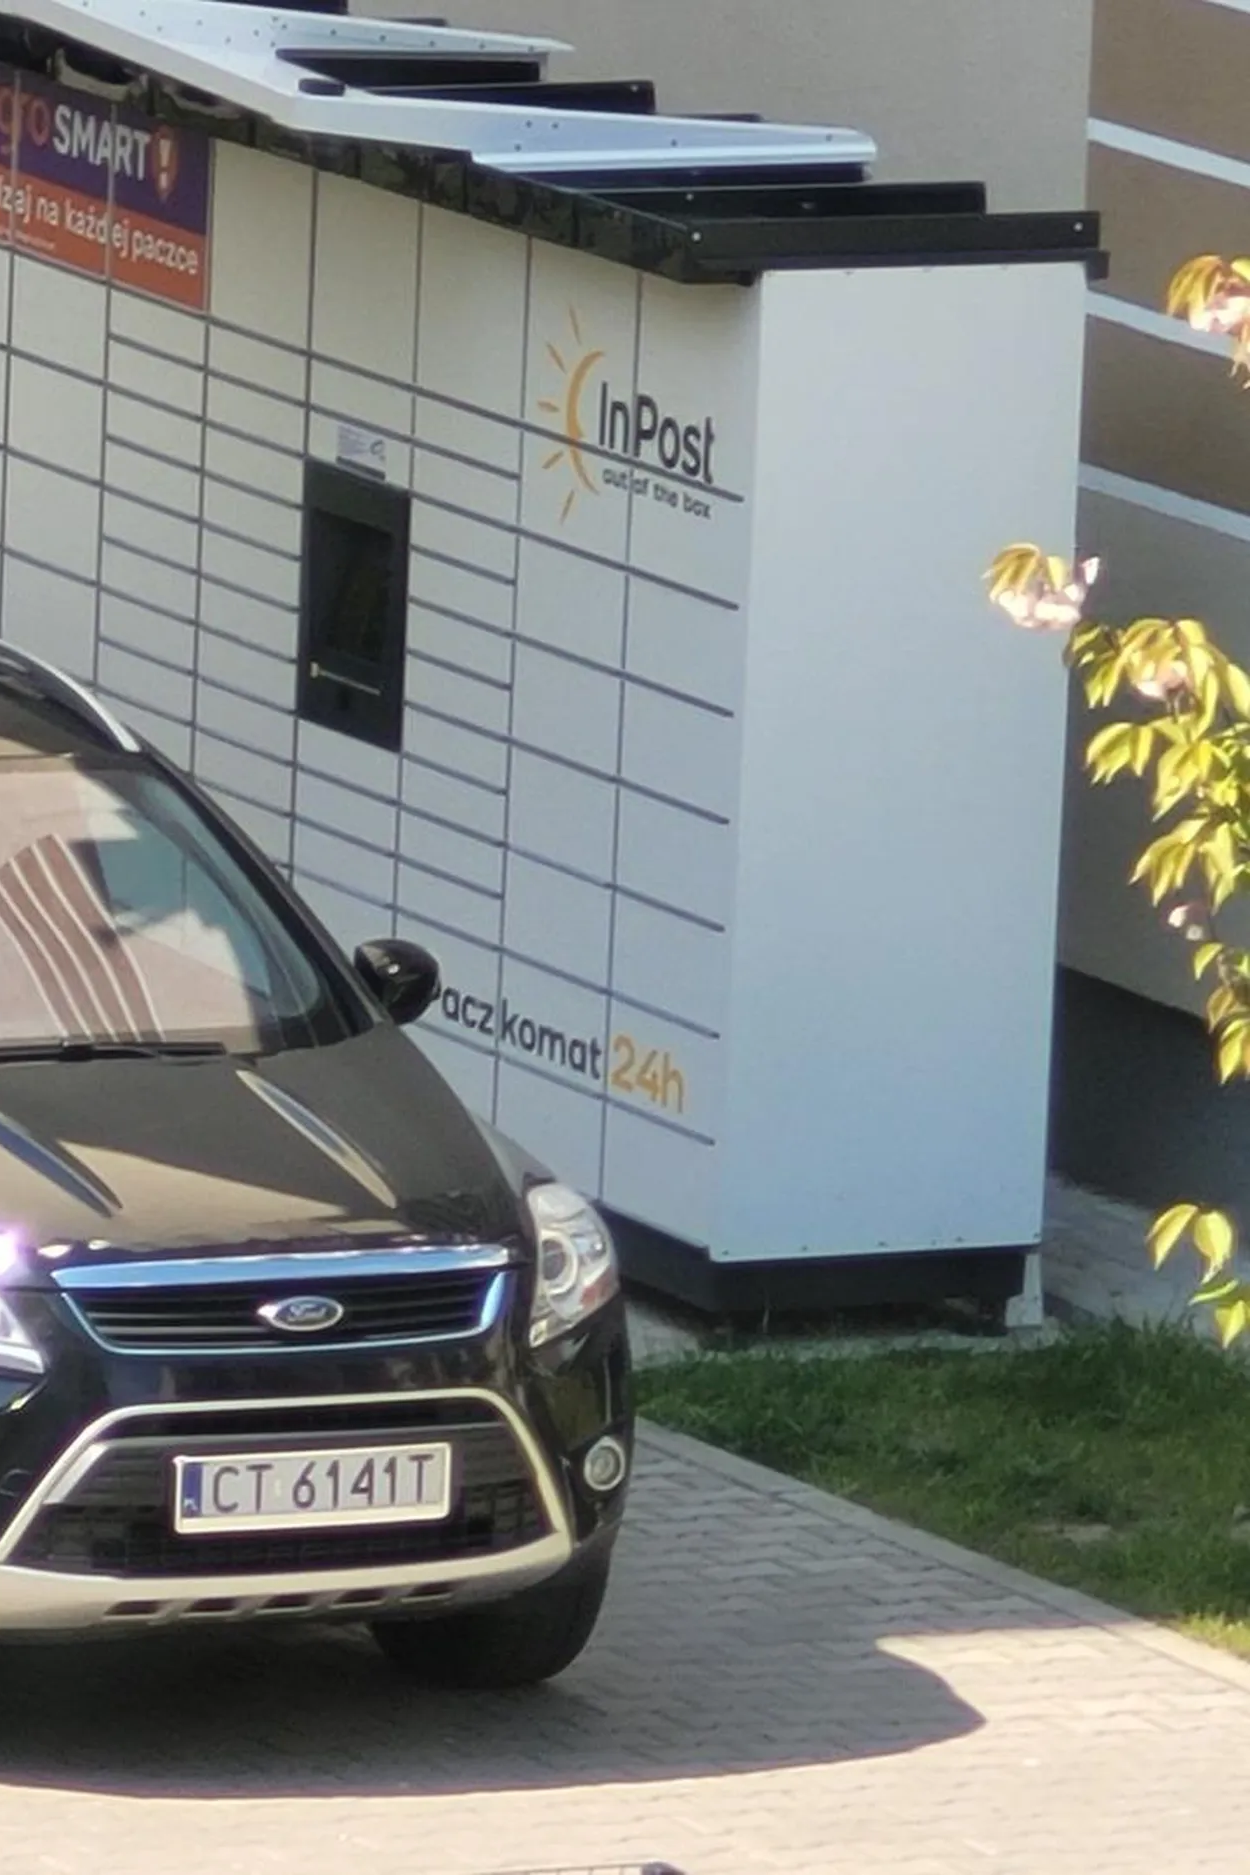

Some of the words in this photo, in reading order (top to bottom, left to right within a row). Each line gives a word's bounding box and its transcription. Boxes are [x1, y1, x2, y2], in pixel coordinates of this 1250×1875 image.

[36, 197, 58, 225] na
[64, 198, 130, 258] każdej
[599, 380, 715, 485] InPost
[653, 483, 679, 508] the
[682, 492, 711, 519] box
[610, 1033, 685, 1114] 24h
[212, 1463, 274, 1514] CT
[291, 1454, 435, 1510] 6141T
